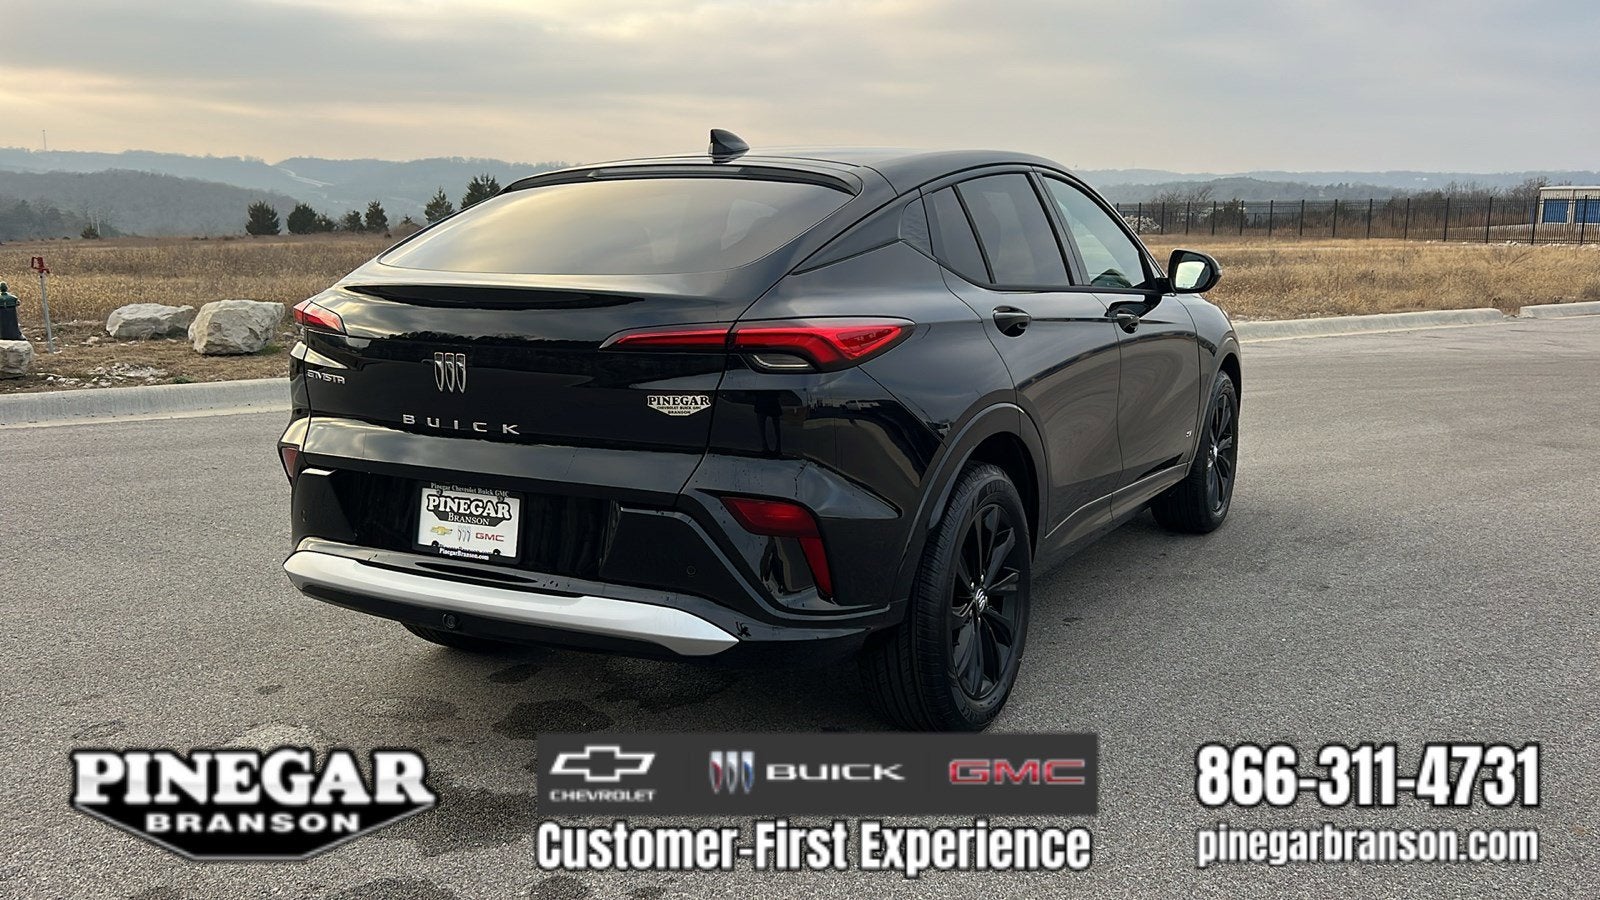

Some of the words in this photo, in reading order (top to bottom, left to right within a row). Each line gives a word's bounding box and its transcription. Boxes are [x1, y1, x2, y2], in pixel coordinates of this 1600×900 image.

[648, 396, 710, 405] PINEGAR
[402, 414, 520, 435] BUICK
[430, 482, 450, 491] Pinegar
[451, 484, 477, 494] Chevrolet
[494, 489, 510, 498] GMC
[428, 496, 511, 518] PINEGAR
[447, 512, 490, 526] BRANSON
[475, 532, 504, 542] GMC
